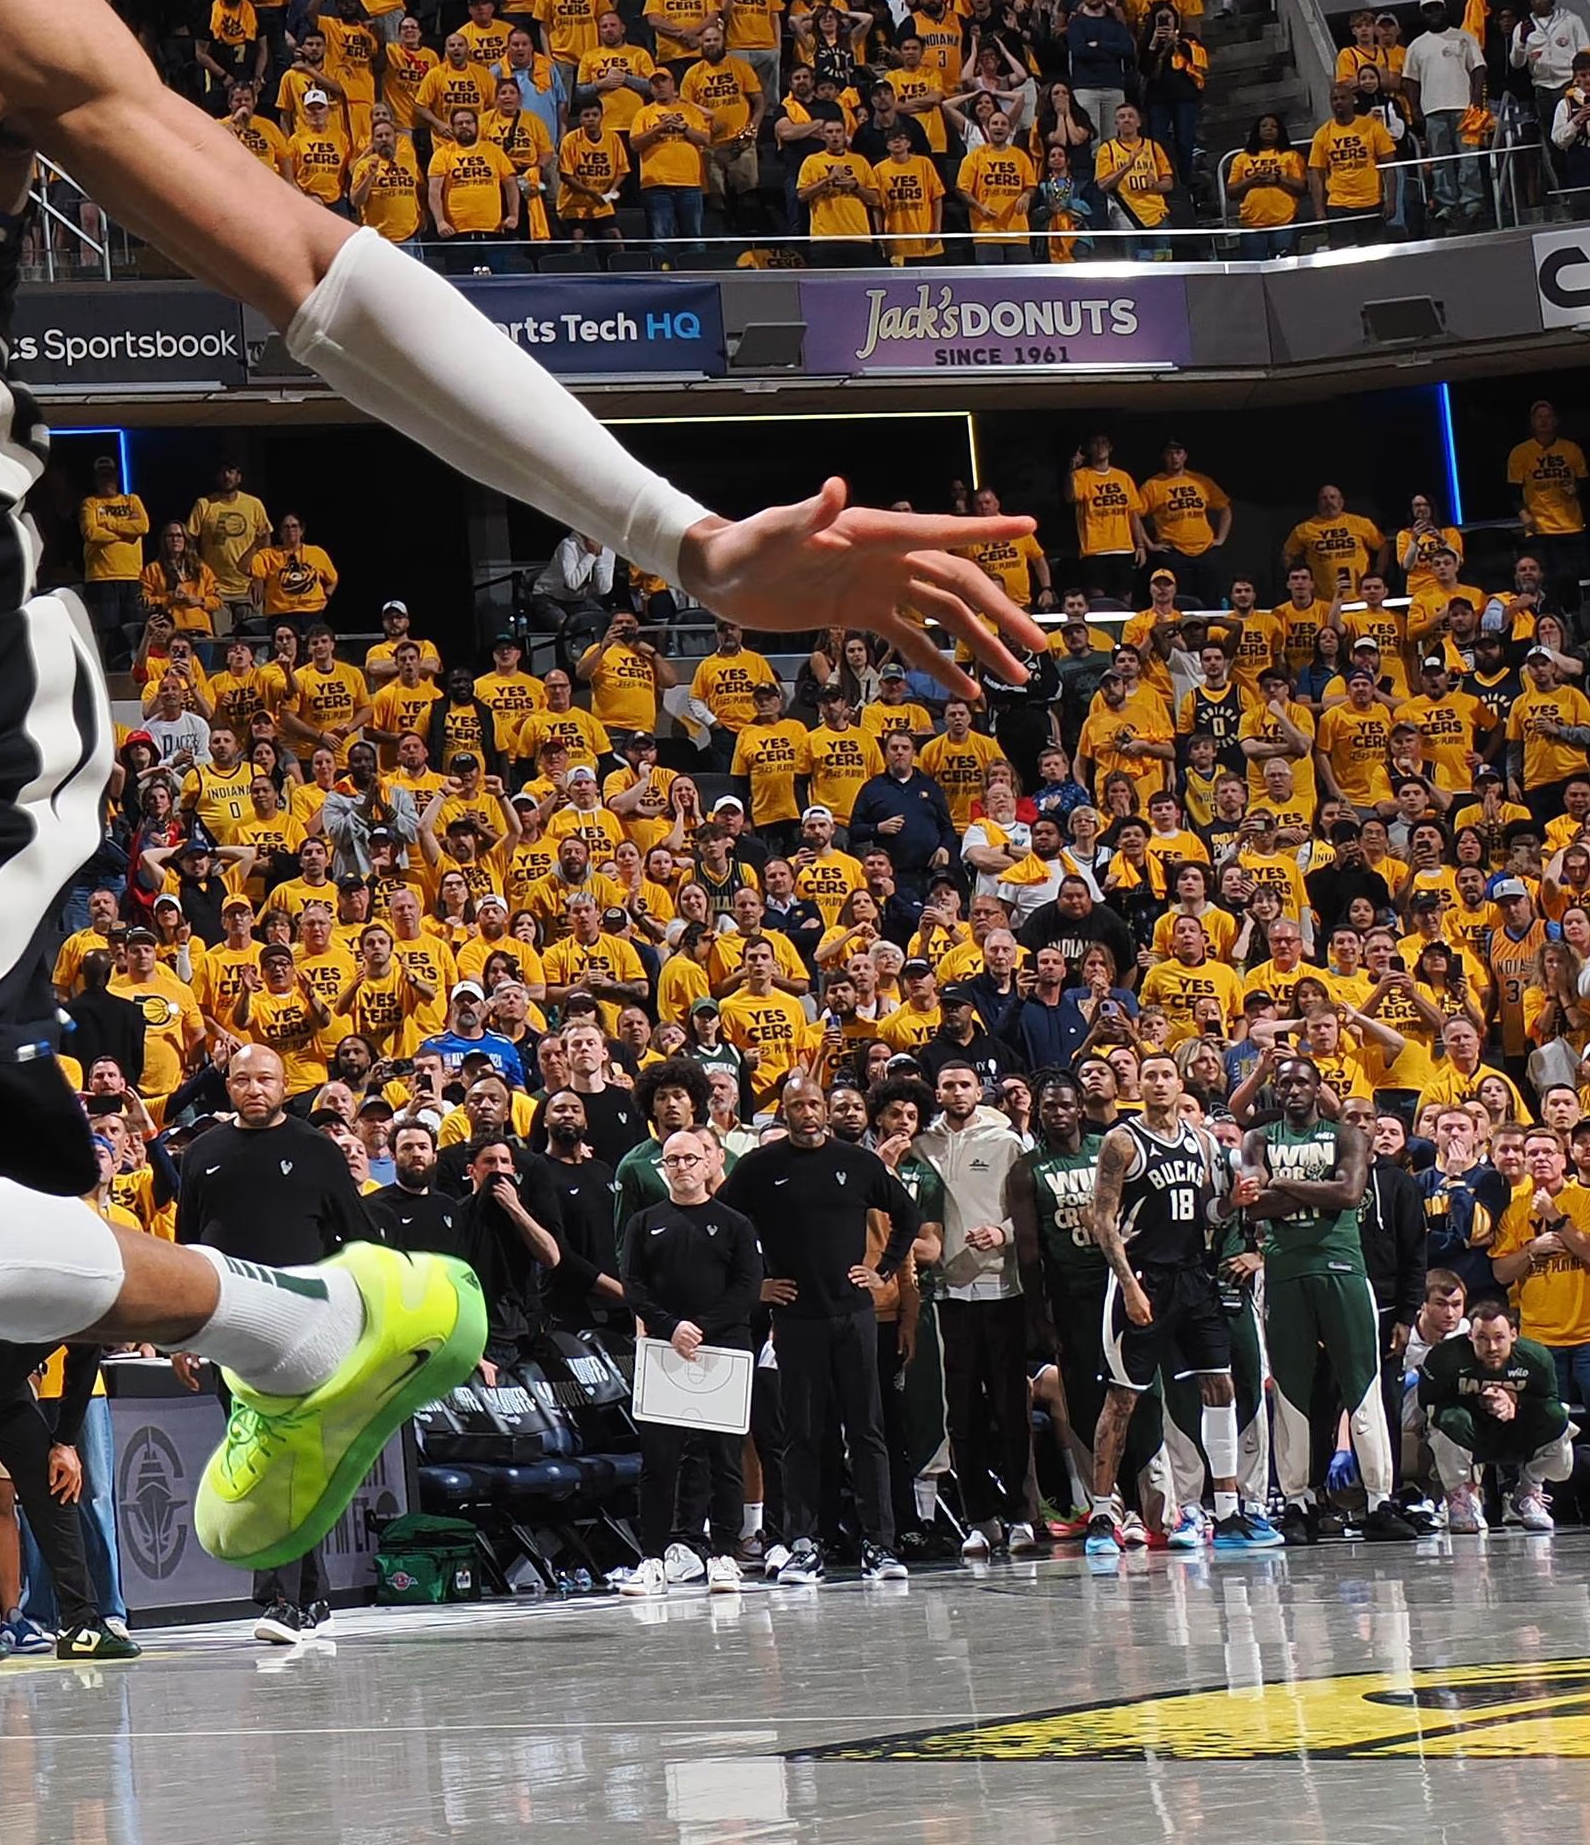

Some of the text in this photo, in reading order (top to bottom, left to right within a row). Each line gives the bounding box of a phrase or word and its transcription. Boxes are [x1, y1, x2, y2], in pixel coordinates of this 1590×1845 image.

[561, 314, 637, 343] Tech
[646, 311, 702, 342] HQ
[855, 284, 1138, 361] Jack's DONUTS
[43, 329, 238, 362] Sportsbook
[934, 346, 1070, 366] SINCE 1961
[1267, 1143, 1335, 1169] WIN
[1147, 1159, 1204, 1190] BUCKS
[1170, 1189, 1194, 1221] 18
